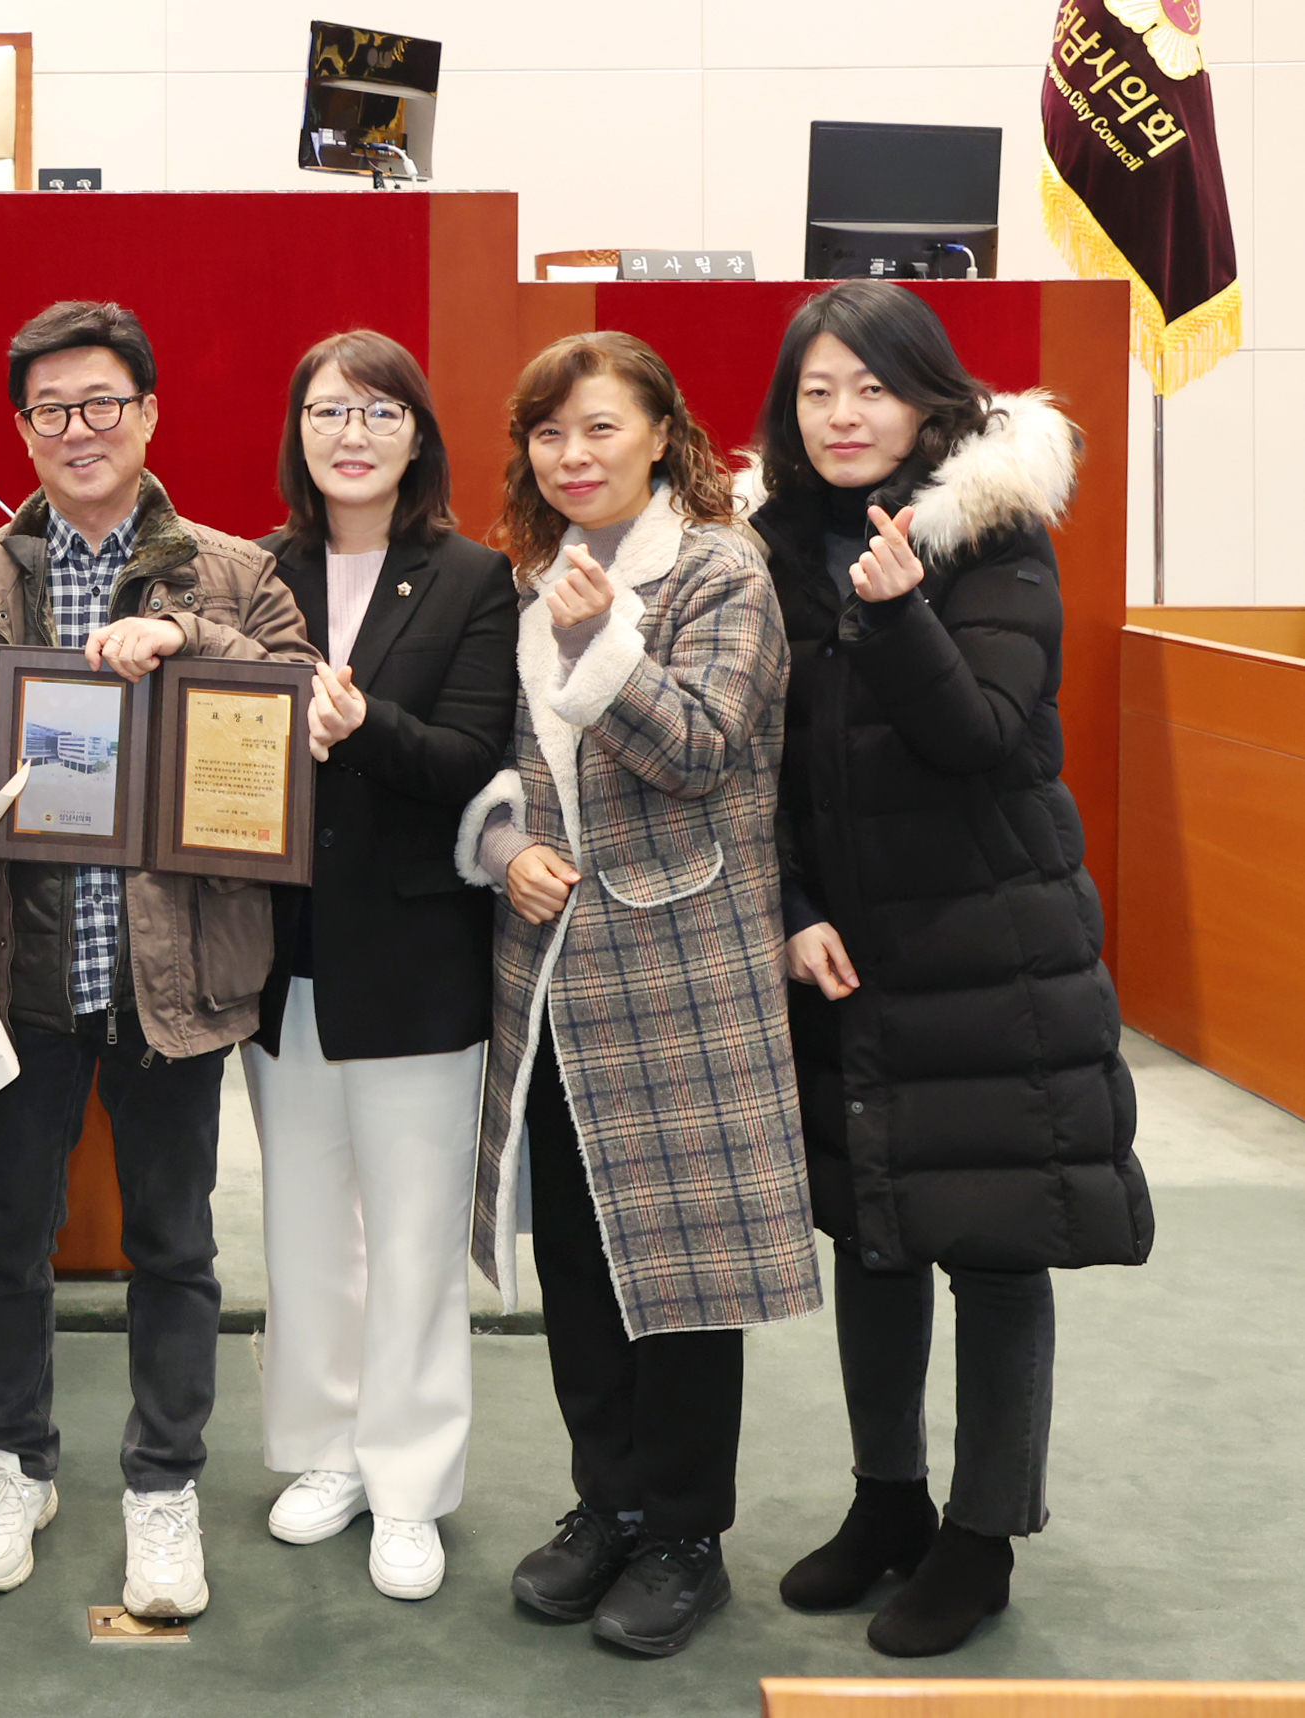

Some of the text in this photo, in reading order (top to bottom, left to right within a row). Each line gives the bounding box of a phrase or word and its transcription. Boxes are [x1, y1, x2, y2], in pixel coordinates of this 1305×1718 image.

[1054, 0, 1187, 158] 성남시의회
[1068, 90, 1095, 122] City
[1090, 116, 1145, 172] Council
